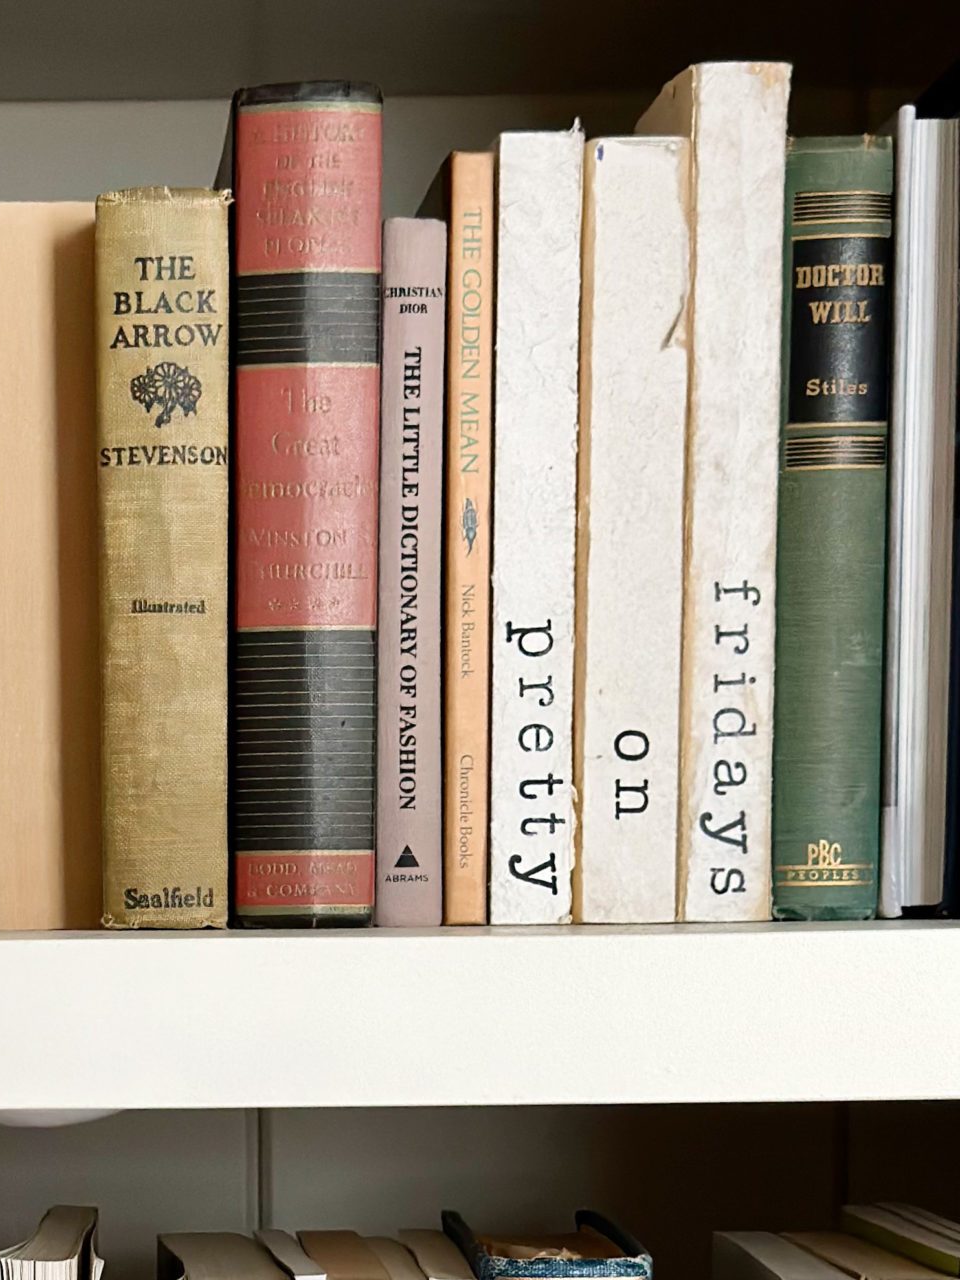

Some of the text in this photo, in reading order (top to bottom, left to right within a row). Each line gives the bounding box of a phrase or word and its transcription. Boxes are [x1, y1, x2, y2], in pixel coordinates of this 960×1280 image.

[134, 256, 196, 281] THE
[795, 263, 885, 289] DOCTOR
[113, 289, 218, 316] BLACK
[399, 303, 428, 314] DIOR
[809, 300, 872, 324] WILL
[109, 323, 223, 350] ARROW
[460, 207, 482, 474] THE GOLDEN MEAN
[806, 378, 868, 396] Stiles
[100, 445, 228, 467] STEVENSON
[399, 347, 422, 811] THE LITTLE DICTIONARY OF FASHION
[131, 599, 206, 615] Illustrated
[461, 584, 476, 679] Nick Bantock
[699, 579, 761, 896] fridays
[506, 618, 566, 896] pretty
[614, 729, 650, 821] on
[459, 754, 474, 869] Chronicle Books
[807, 839, 842, 866] PBC
[384, 874, 429, 883] ABRAMS
[787, 870, 860, 881] PEOPLES
[124, 887, 215, 911] Saalfield
